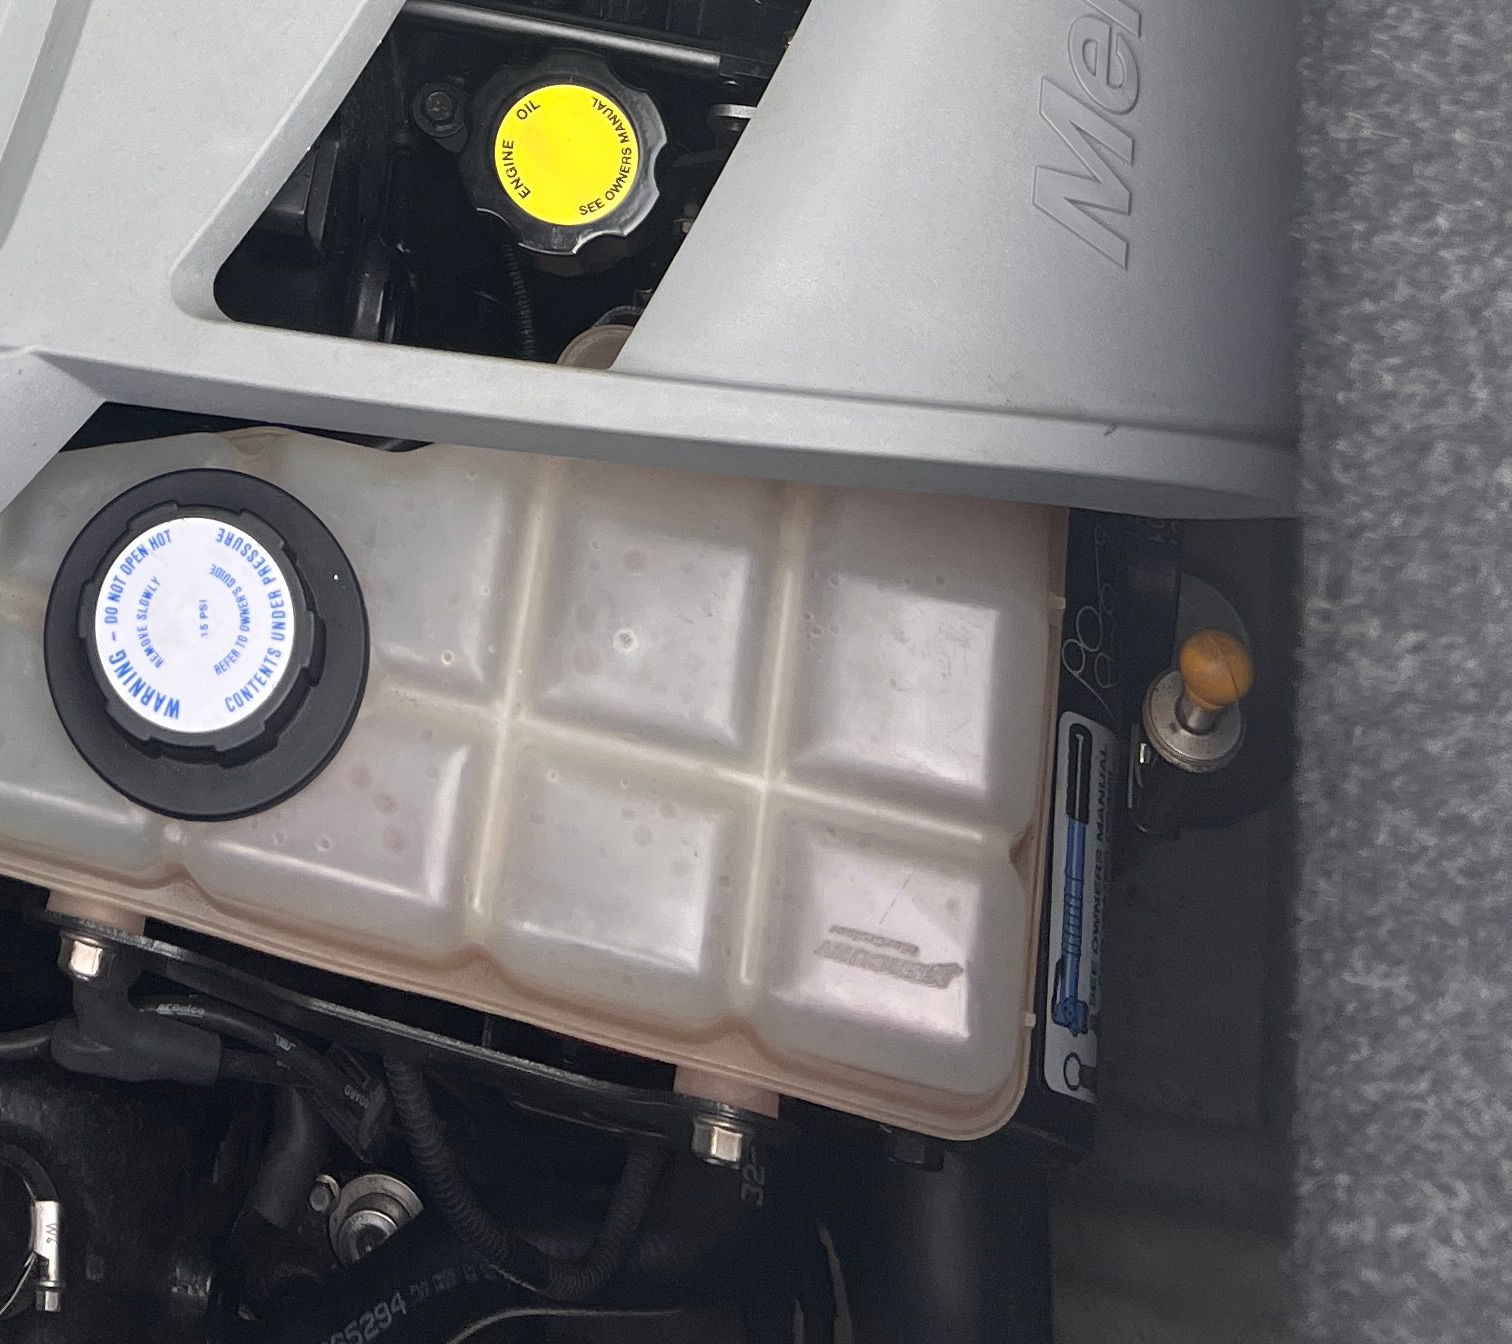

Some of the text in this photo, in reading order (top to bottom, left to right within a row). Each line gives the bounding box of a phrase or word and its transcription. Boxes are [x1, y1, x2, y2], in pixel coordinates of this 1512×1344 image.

[501, 100, 541, 199] ENGINE OIL
[578, 97, 632, 216] SEE OWNERS MANUAL
[119, 543, 150, 576] OPEN
[147, 528, 172, 552] HOT
[104, 606, 118, 625] DO
[107, 575, 127, 603] NOT
[136, 575, 165, 669] REMOVE SLOWLY
[198, 599, 209, 639] 15 PSI
[208, 563, 251, 677] REFER TO OWNER'S GUIDE
[216, 527, 286, 713] CONTENTS UNDER PRESSURE
[108, 649, 181, 720] WARNING
[1095, 743, 1108, 843] MANUAL
[1090, 848, 1104, 955] OWNERS
